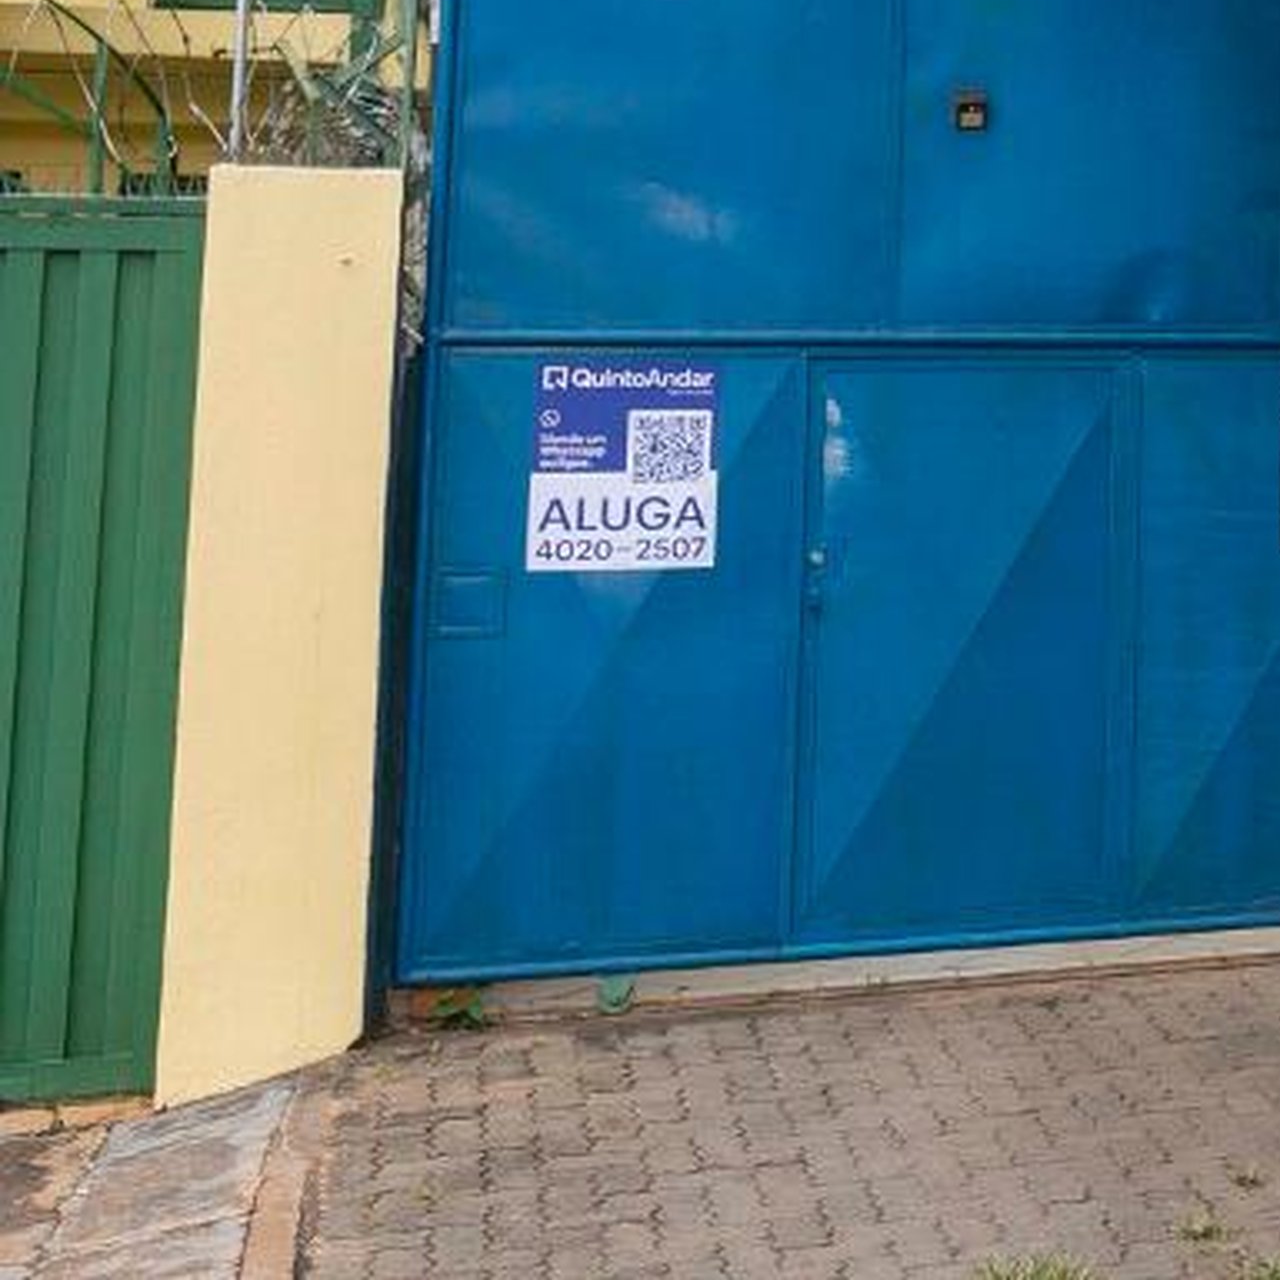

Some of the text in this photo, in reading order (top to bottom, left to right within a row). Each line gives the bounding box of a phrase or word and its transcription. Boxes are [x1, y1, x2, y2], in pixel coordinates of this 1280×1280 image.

[571, 368, 715, 389] QuintoAndar
[537, 496, 706, 533] ALUGA
[535, 536, 707, 562] 4020-2507
